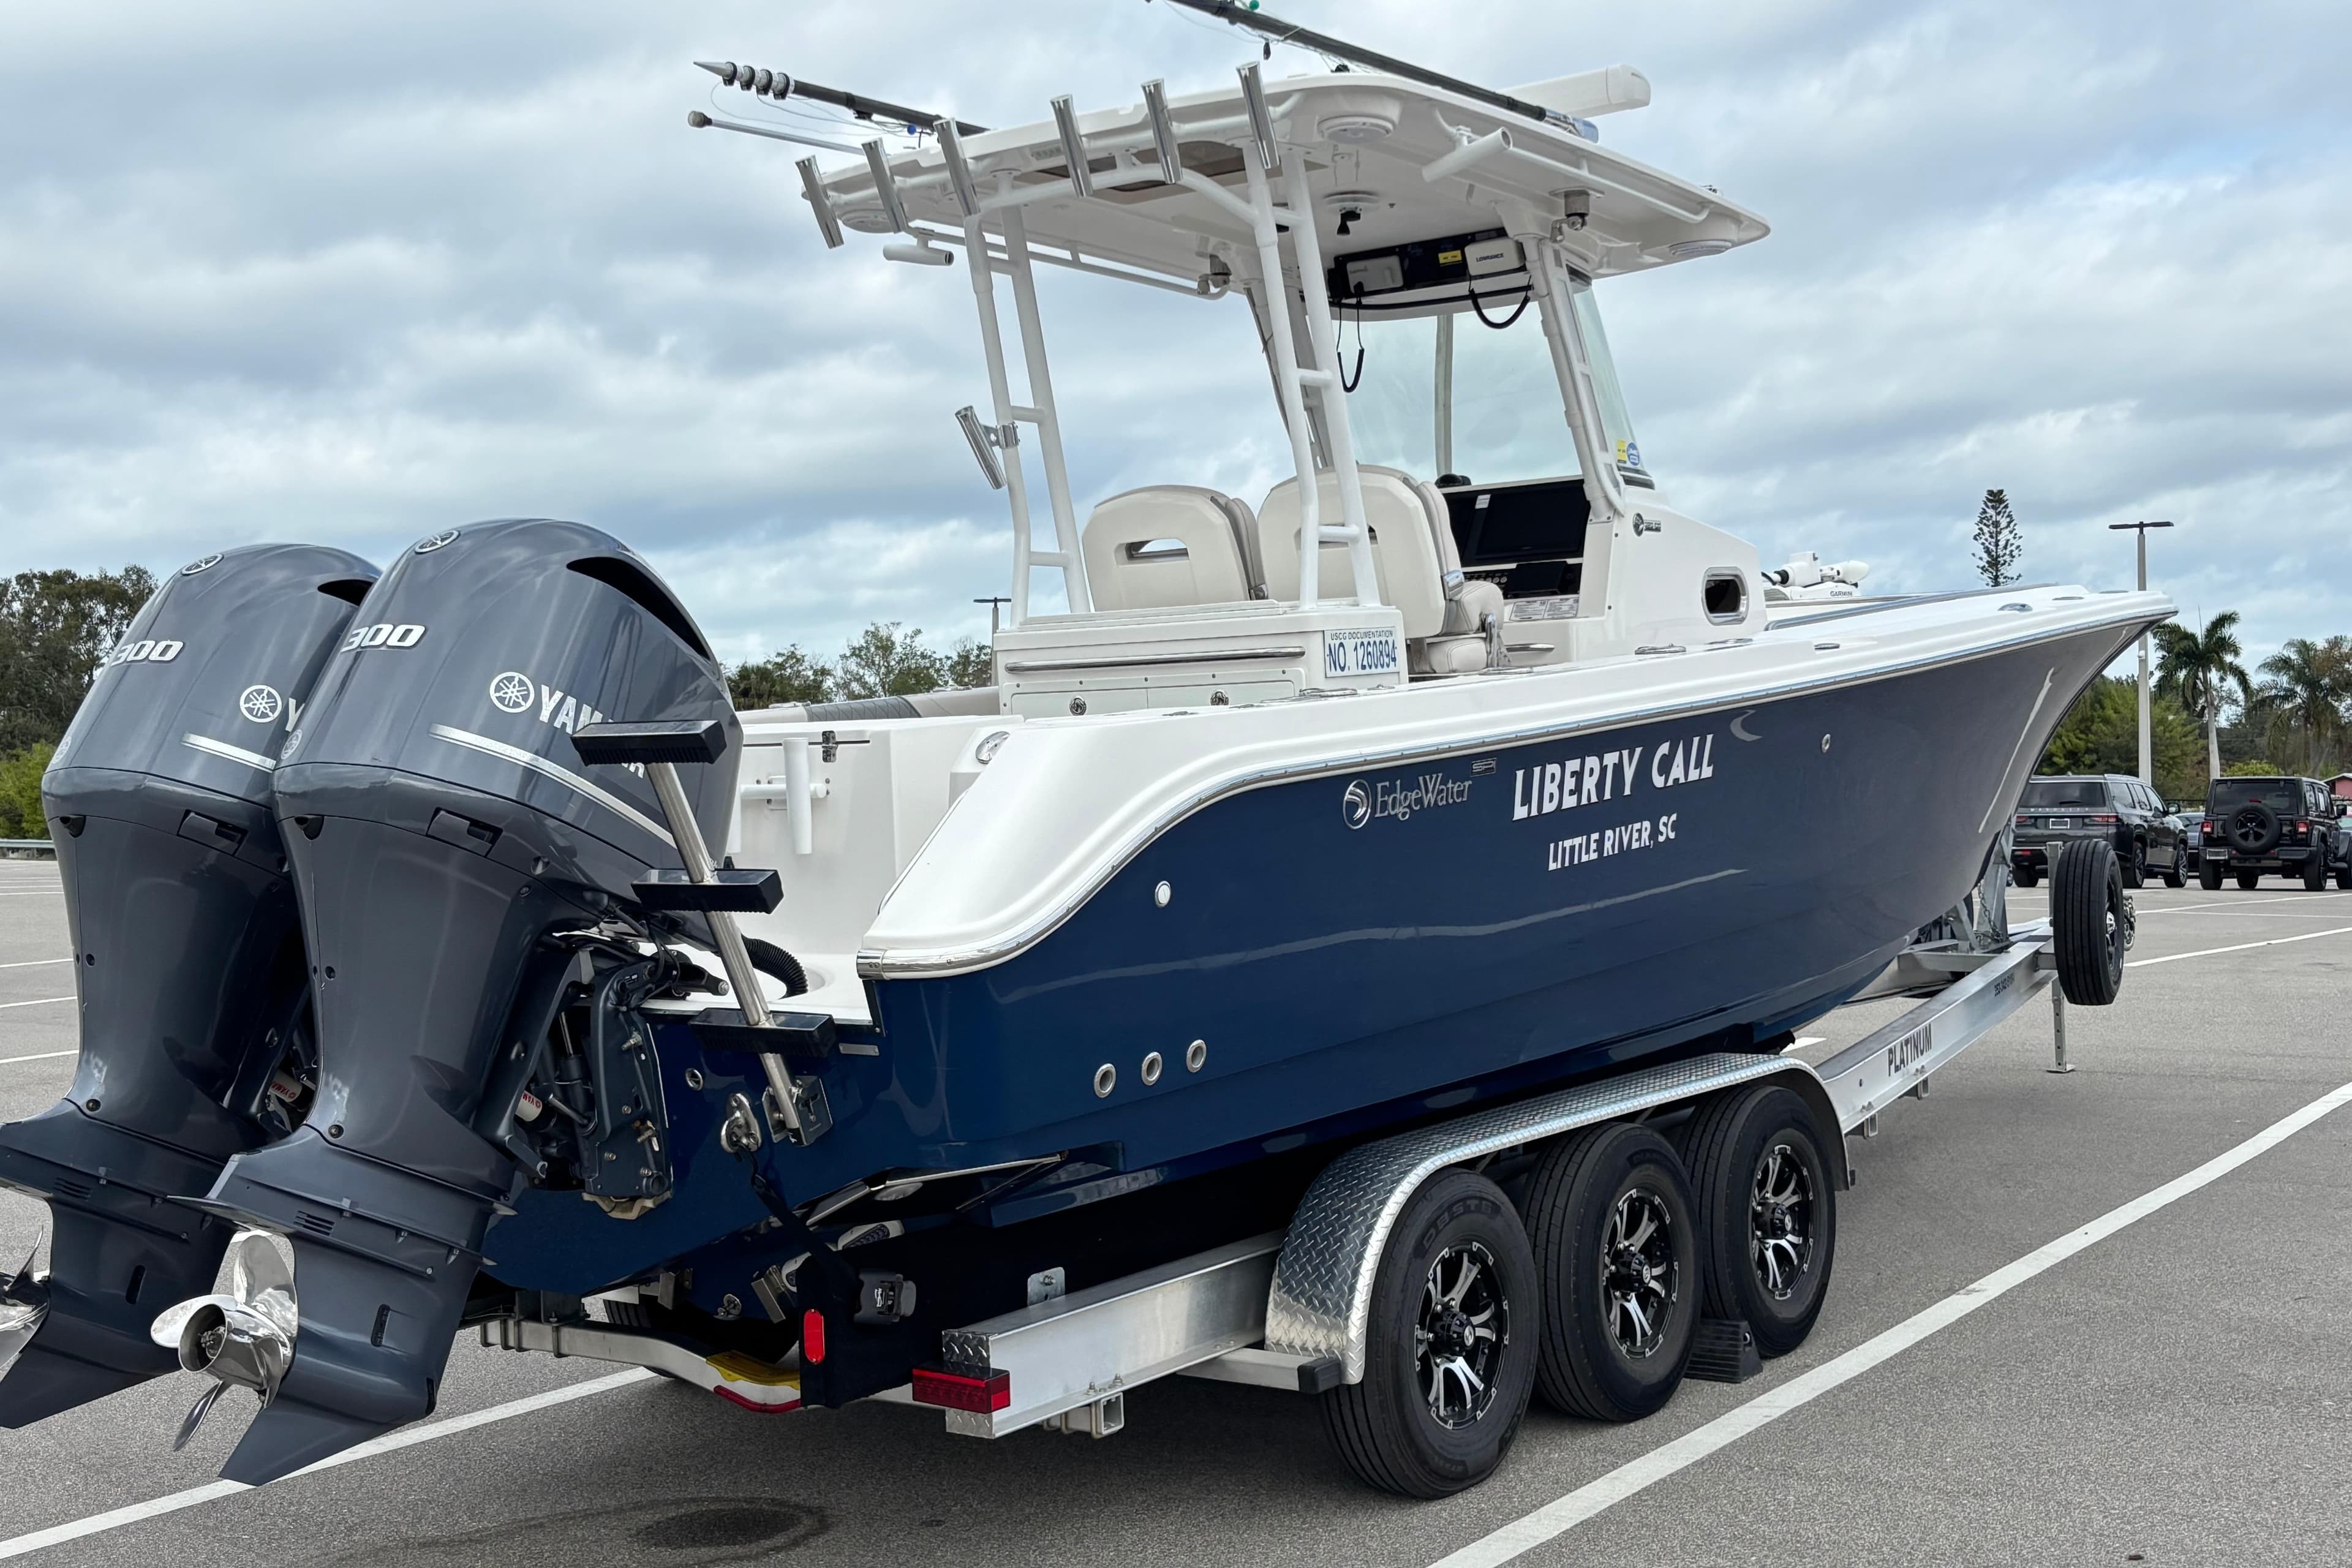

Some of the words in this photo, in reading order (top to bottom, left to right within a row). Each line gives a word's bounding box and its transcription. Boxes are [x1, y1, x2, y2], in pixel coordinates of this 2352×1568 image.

[110, 639, 184, 667] 300
[341, 624, 426, 654] 300
[1328, 642, 1351, 672] NO.
[1354, 639, 1396, 671] 1260894
[1330, 632, 1347, 641] USCG
[1348, 630, 1393, 640] DOCUMENTATION
[1374, 772, 1472, 821] EdgeWater
[1512, 746, 1643, 821] LIBERTY
[1651, 733, 1714, 788] CALL
[1548, 832, 1600, 871] LITTLE
[1603, 820, 1654, 857] RIVER,
[1657, 812, 1678, 843] SC
[1888, 1023, 1932, 1077] PLATINUM
